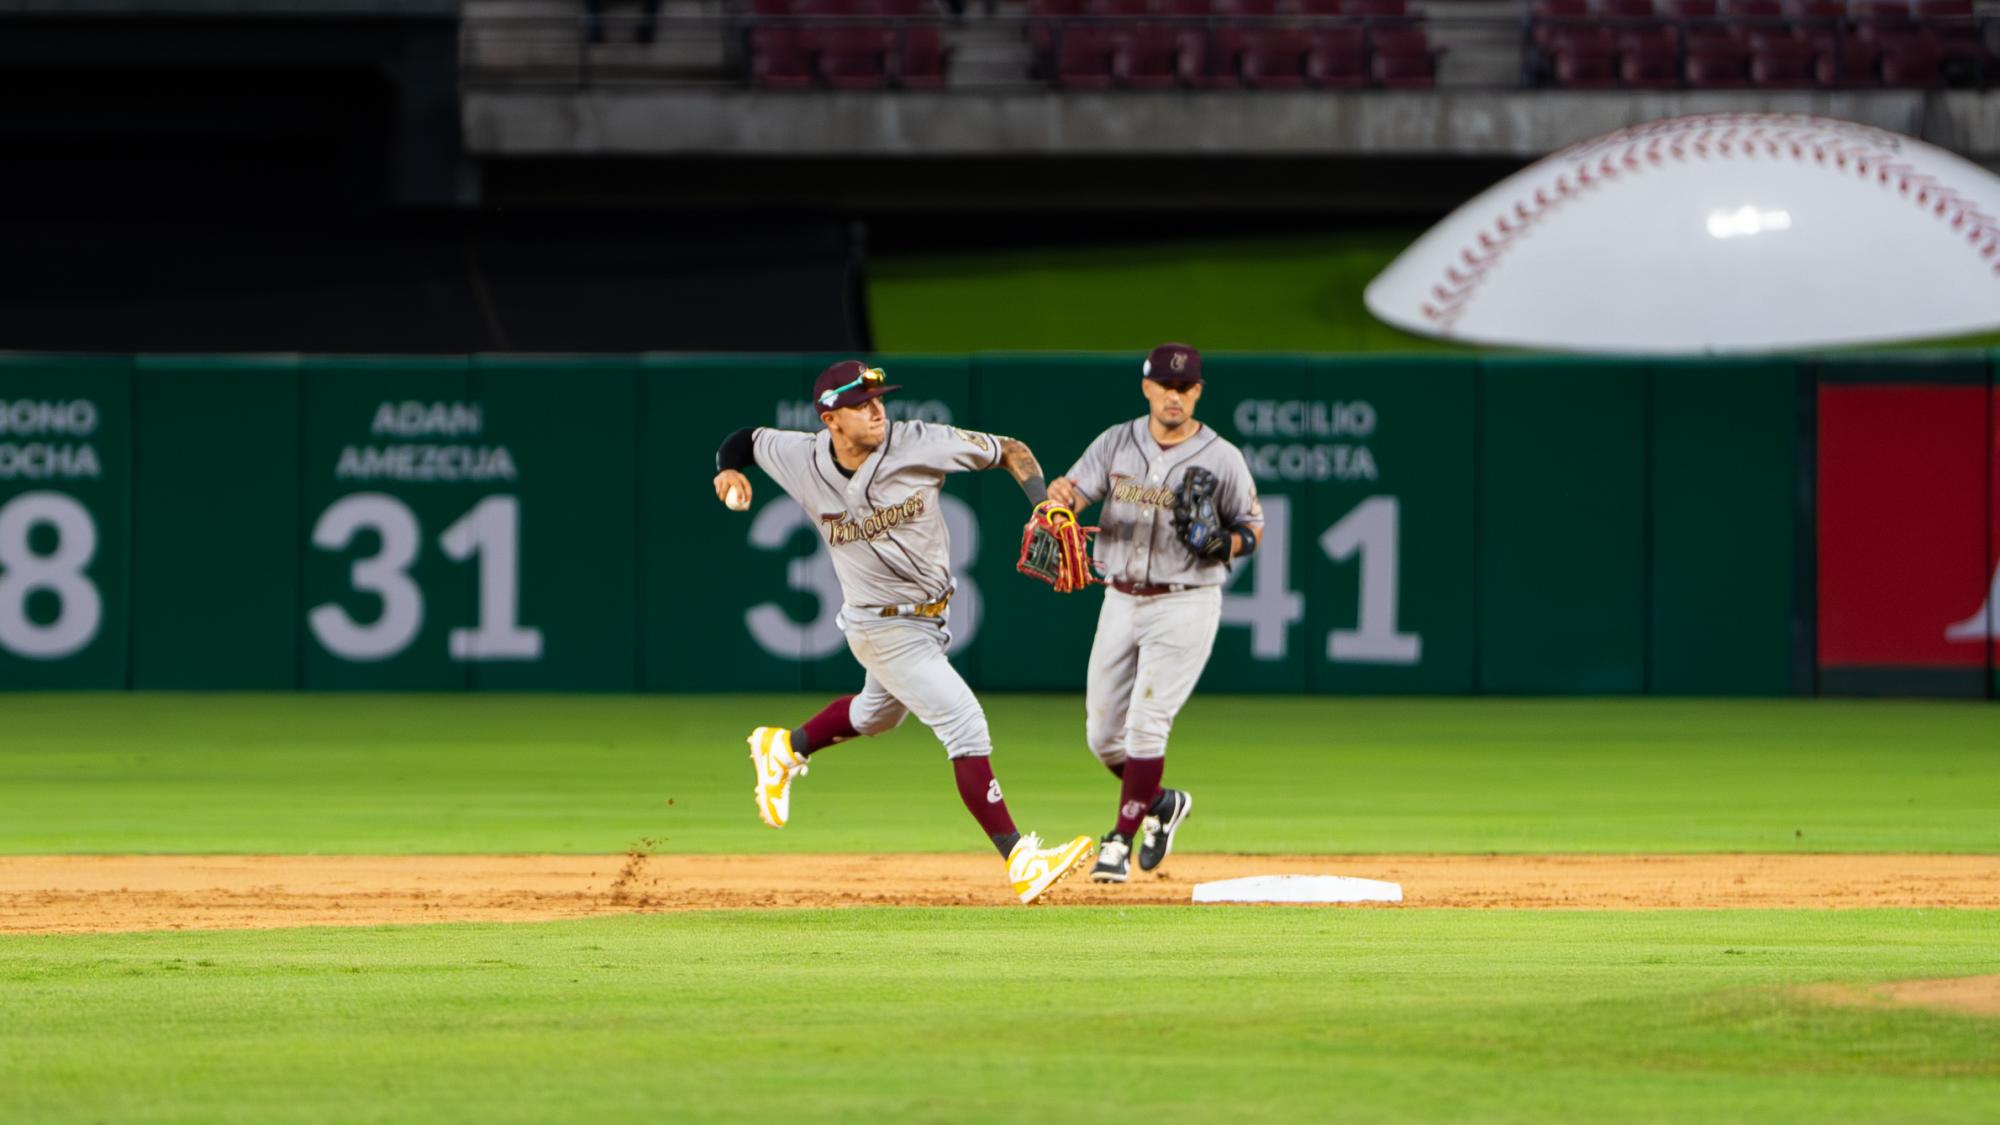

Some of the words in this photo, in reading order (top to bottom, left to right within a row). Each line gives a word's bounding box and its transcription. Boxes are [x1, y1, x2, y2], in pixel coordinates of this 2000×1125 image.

[371, 402, 482, 435] ADAN
[1234, 401, 1377, 436] CECILIO
[335, 445, 517, 480] AMEZCUA
[308, 491, 544, 661] 31
[1220, 495, 1422, 664] 41
